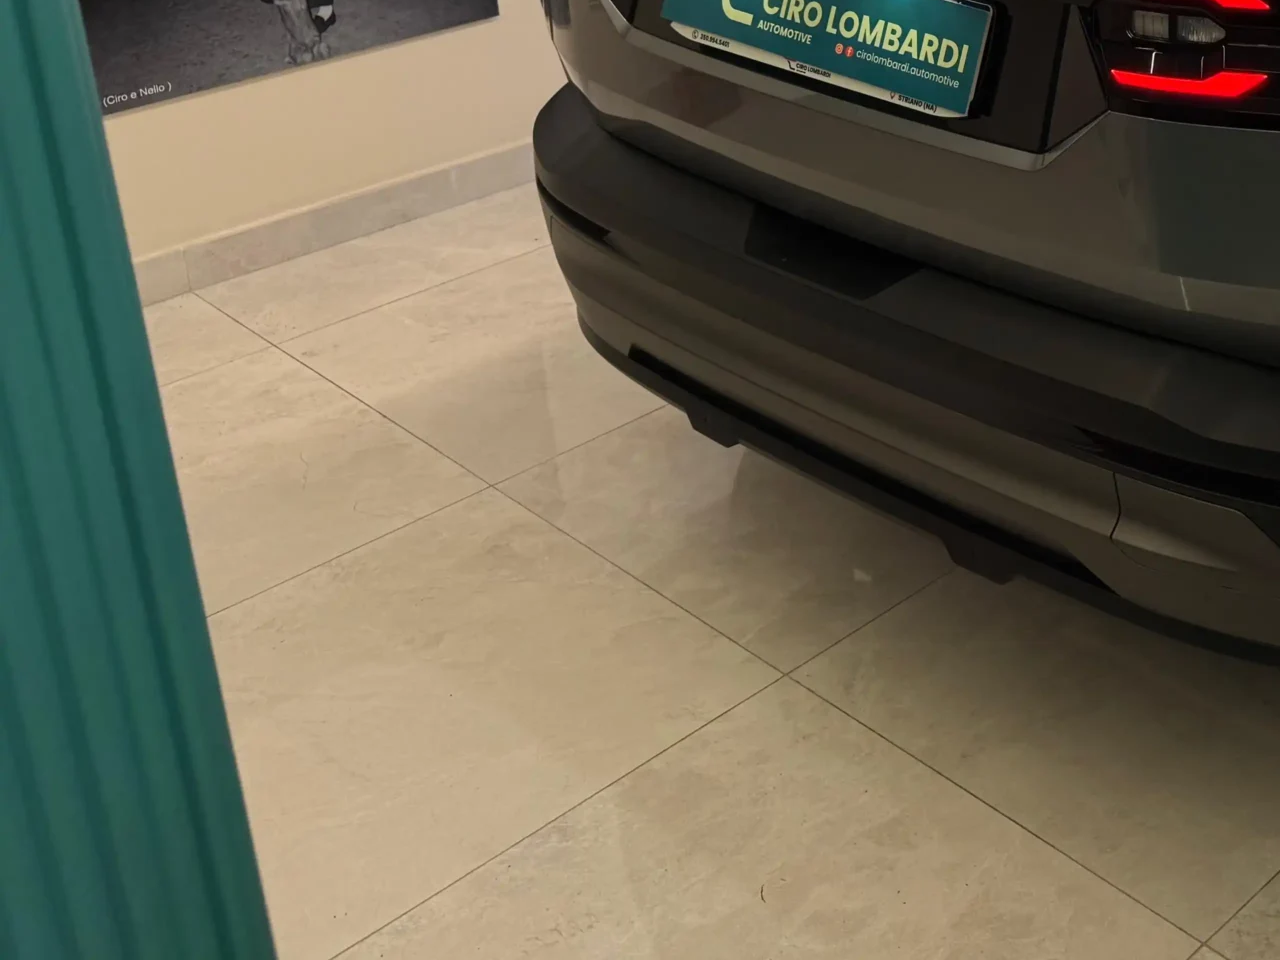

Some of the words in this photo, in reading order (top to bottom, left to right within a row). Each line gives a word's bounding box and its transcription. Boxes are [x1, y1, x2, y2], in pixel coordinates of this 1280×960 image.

[757, 19, 812, 45] AUTOMOTIVE
[825, 5, 970, 74] LOMBARDI
[856, 49, 960, 89] cirolombardi.automotive
[103, 95, 128, 108] (Ciro
[130, 91, 137, 99] e
[139, 83, 165, 97] Nello
[898, 94, 923, 109] STRIANO
